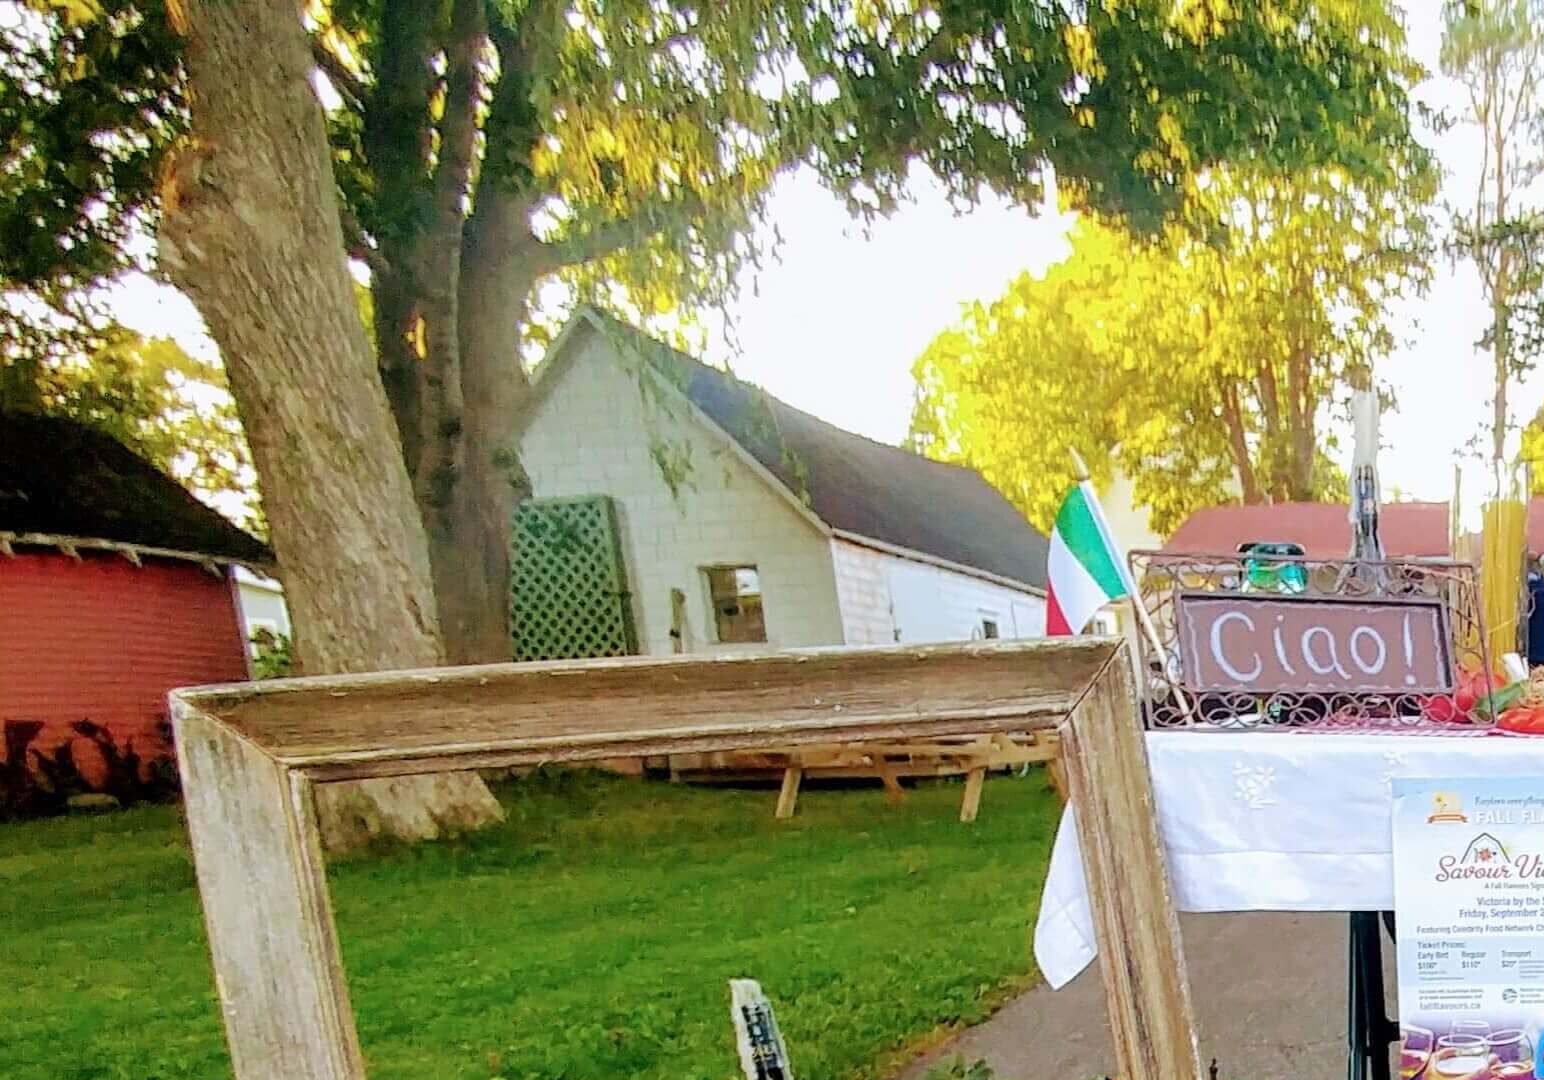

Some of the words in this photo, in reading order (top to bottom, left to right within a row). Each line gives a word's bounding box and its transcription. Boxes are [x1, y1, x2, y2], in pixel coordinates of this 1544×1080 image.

[1209, 610, 1417, 687] Ciao!
[1475, 809, 1516, 824] FALL
[1435, 855, 1513, 882] Savour
[1476, 897, 1511, 906] Victoria
[1512, 897, 1524, 907] by
[1526, 896, 1541, 905] the
[1459, 909, 1489, 920] Friday,
[1490, 908, 1538, 919] September
